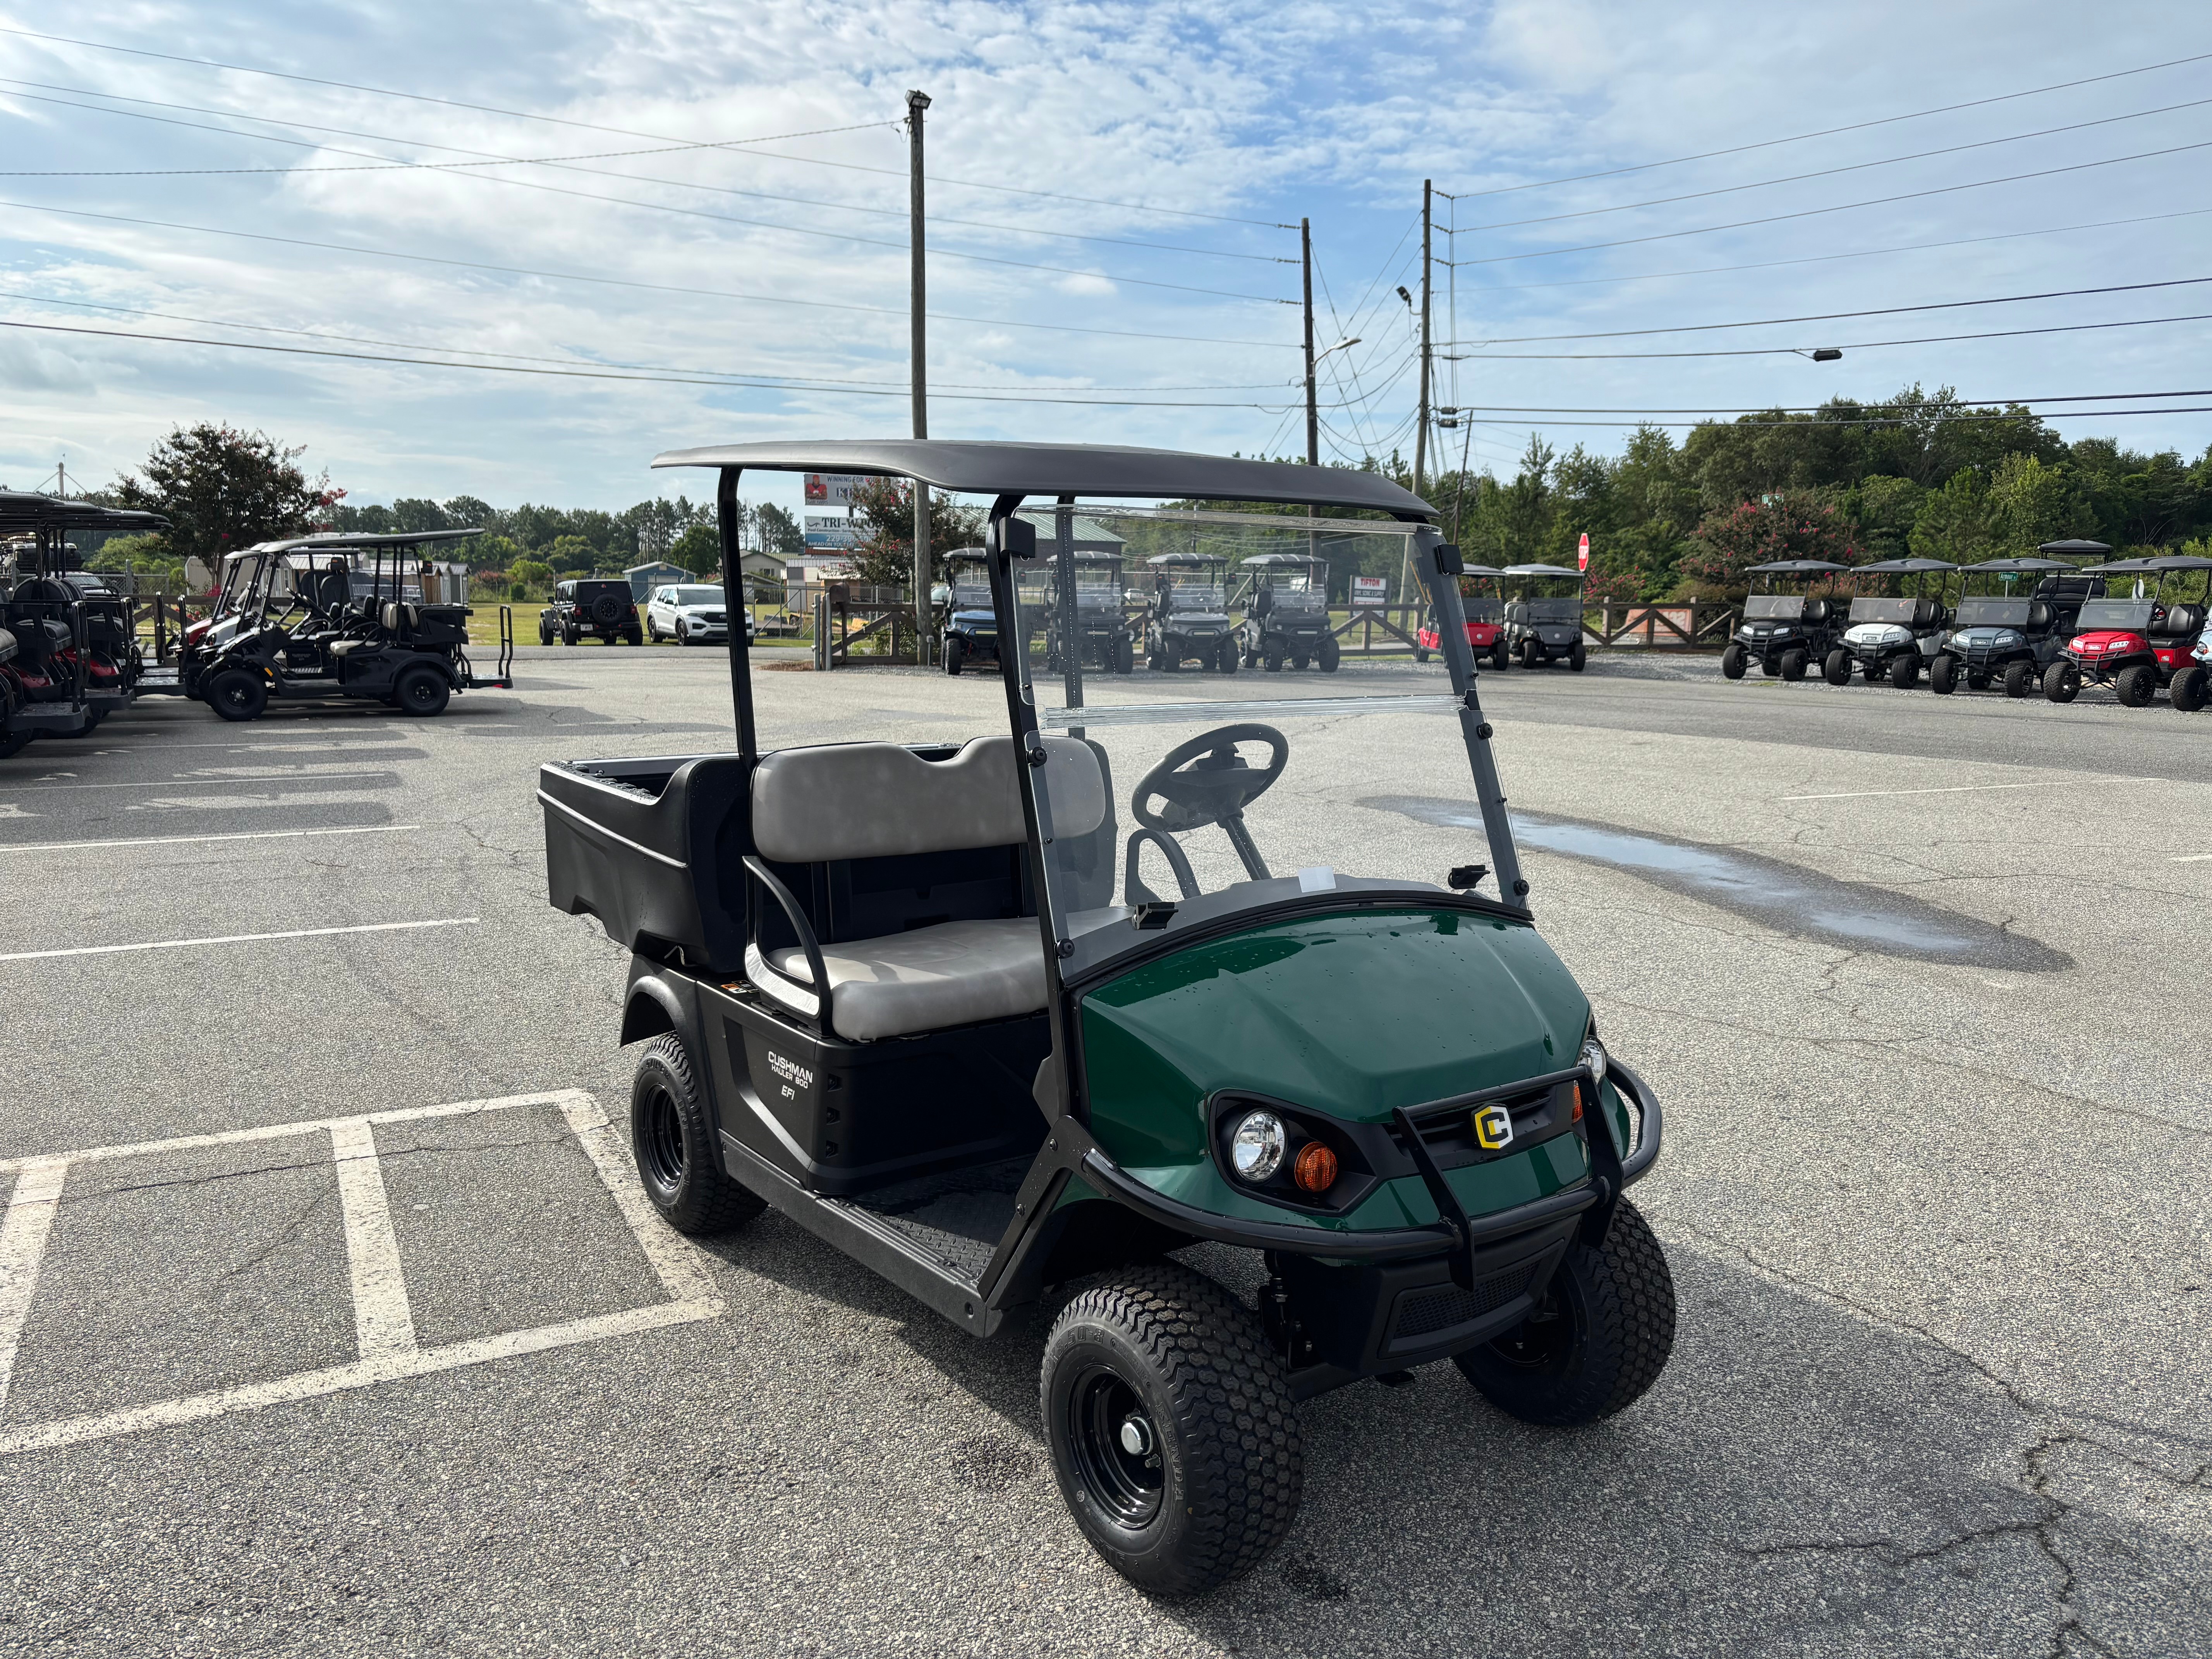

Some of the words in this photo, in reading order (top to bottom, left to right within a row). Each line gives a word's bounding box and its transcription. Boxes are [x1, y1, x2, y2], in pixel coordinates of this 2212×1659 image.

[822, 517, 858, 528] TRI-W
[1578, 545, 1589, 559] STOP
[1360, 578, 1380, 587] TIFTON
[768, 1051, 812, 1083] CUSHMAN
[771, 1064, 793, 1081] HAULER
[795, 1077, 808, 1089] 800
[781, 1085, 795, 1100] EFI
[1480, 1112, 1509, 1142] C
[1155, 1402, 1184, 1501] KENDA
